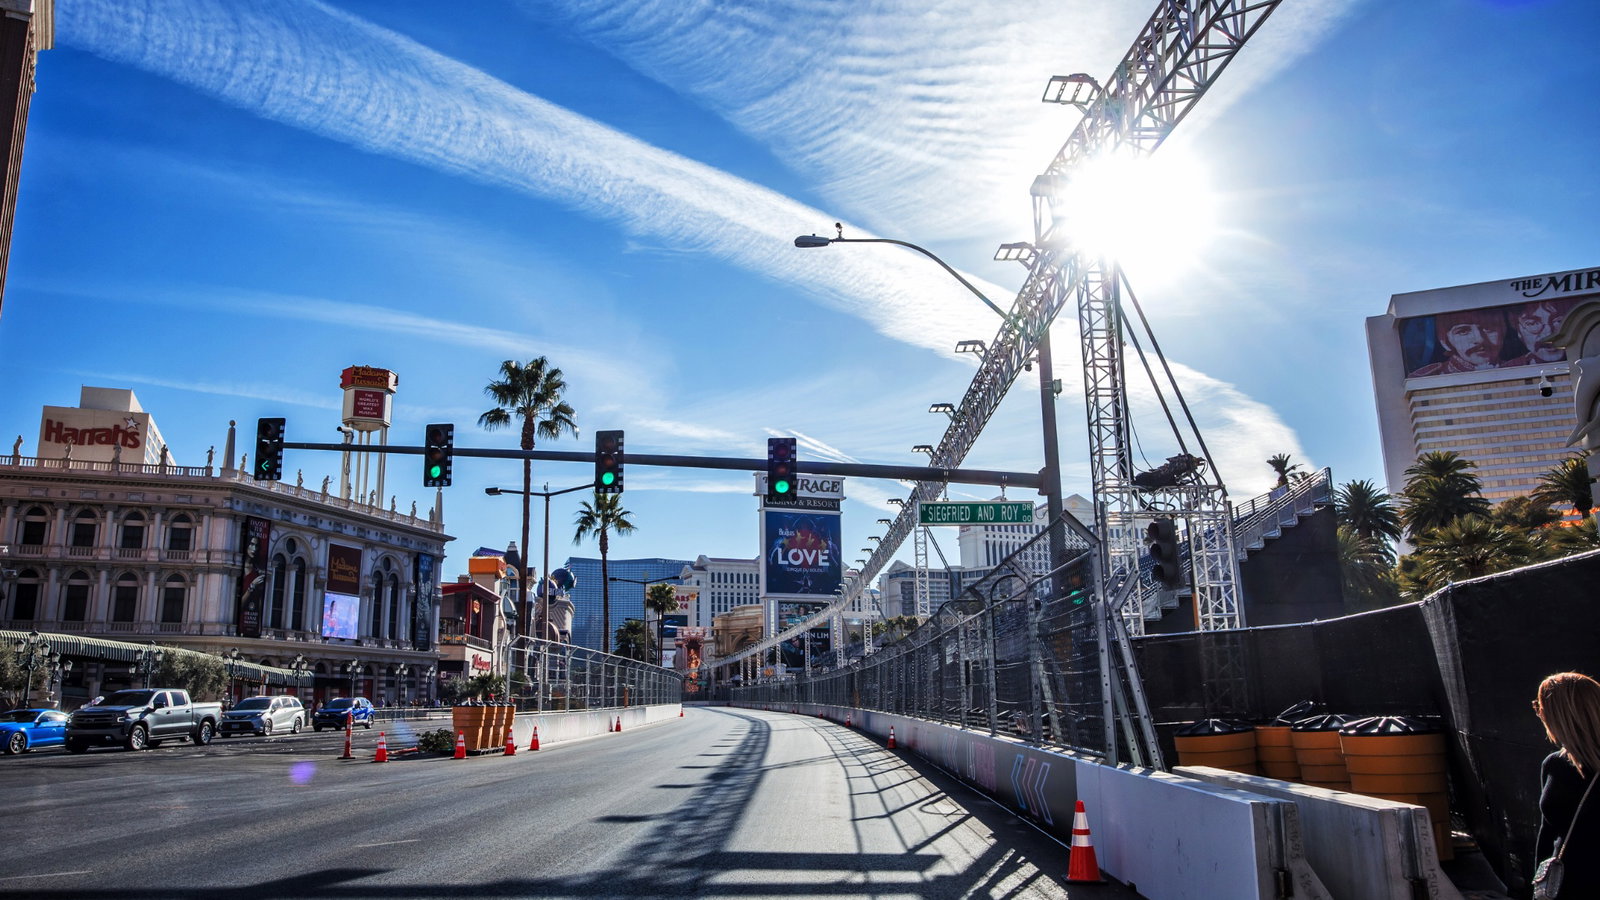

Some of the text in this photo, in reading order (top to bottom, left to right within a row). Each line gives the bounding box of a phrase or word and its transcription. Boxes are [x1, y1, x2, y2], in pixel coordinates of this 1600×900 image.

[1510, 278, 1543, 291] THE
[806, 499, 839, 509] RESORT
[928, 505, 971, 522] SIEGFRIED
[977, 505, 995, 521] AND
[1001, 504, 1019, 521] ROY
[1022, 503, 1032, 511] DR
[777, 547, 830, 567] LOVE
